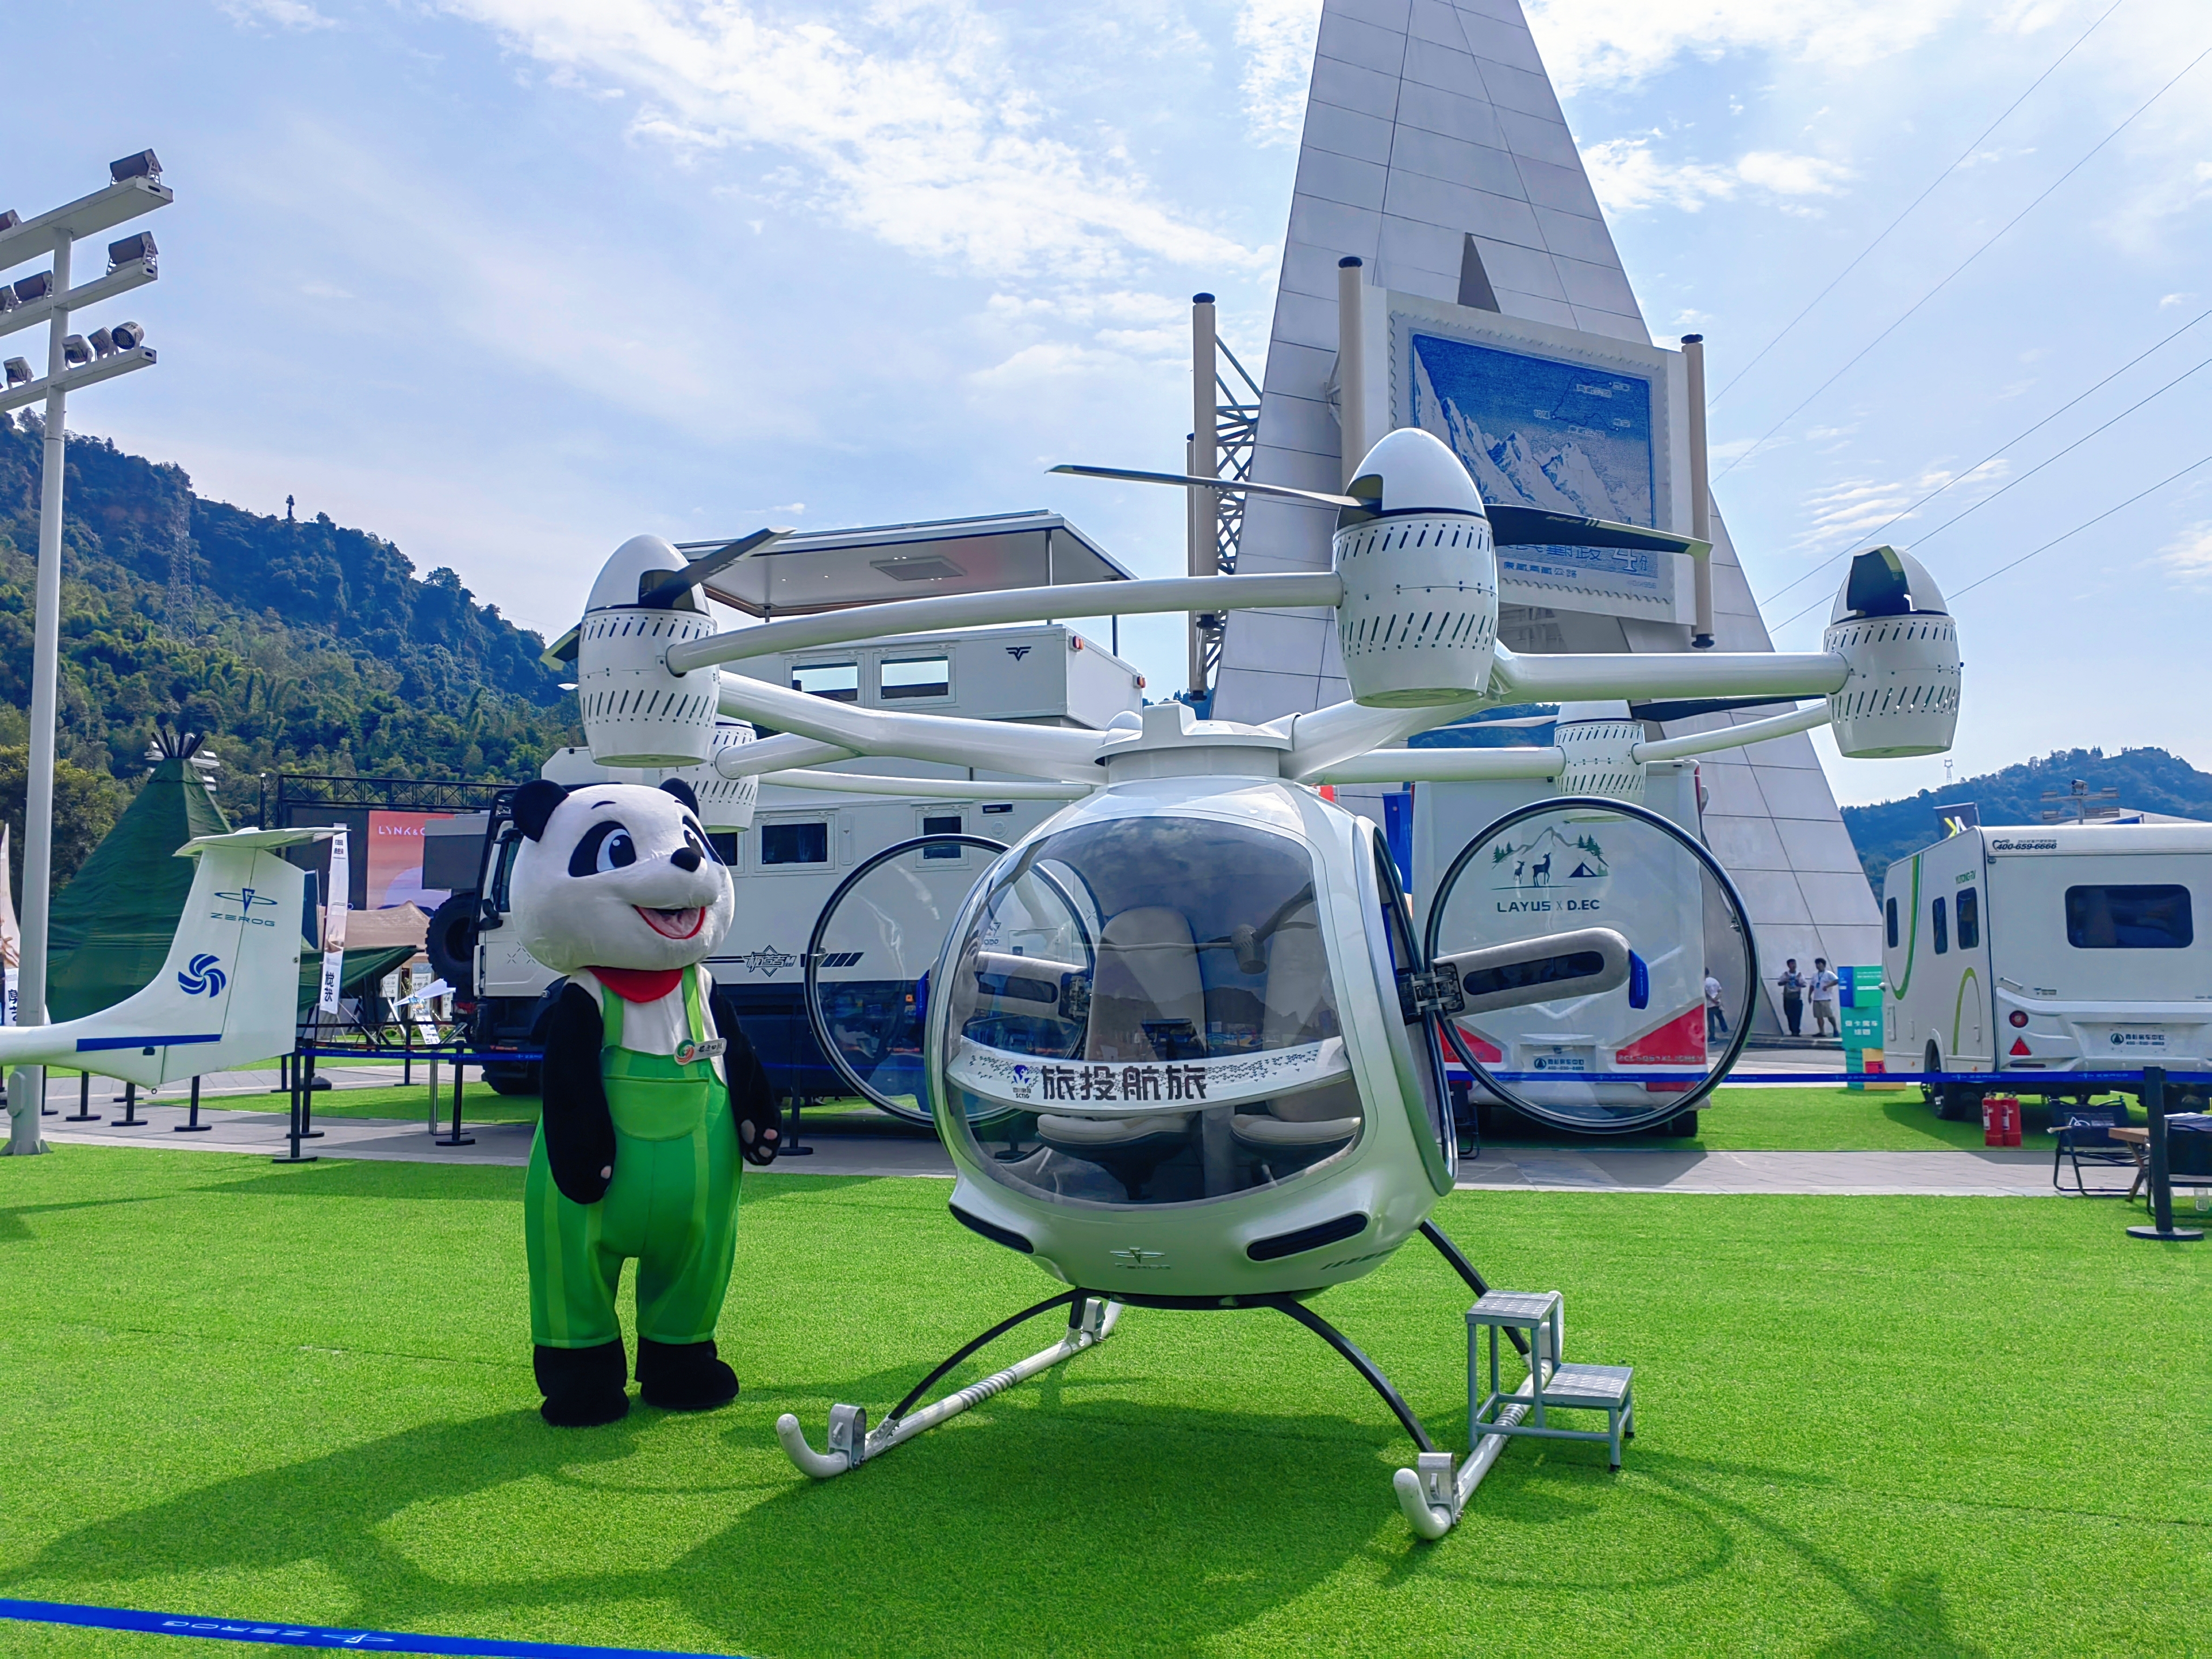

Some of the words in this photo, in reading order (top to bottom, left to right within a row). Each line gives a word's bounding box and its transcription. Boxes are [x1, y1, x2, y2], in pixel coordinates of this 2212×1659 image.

[1497, 901, 1551, 912] LAYUS
[1567, 900, 1600, 911] D.EC
[210, 912, 275, 927] ZEROG
[1041, 1064, 1206, 1101] 旅投航旅
[162, 1621, 311, 1636] ZEROG
